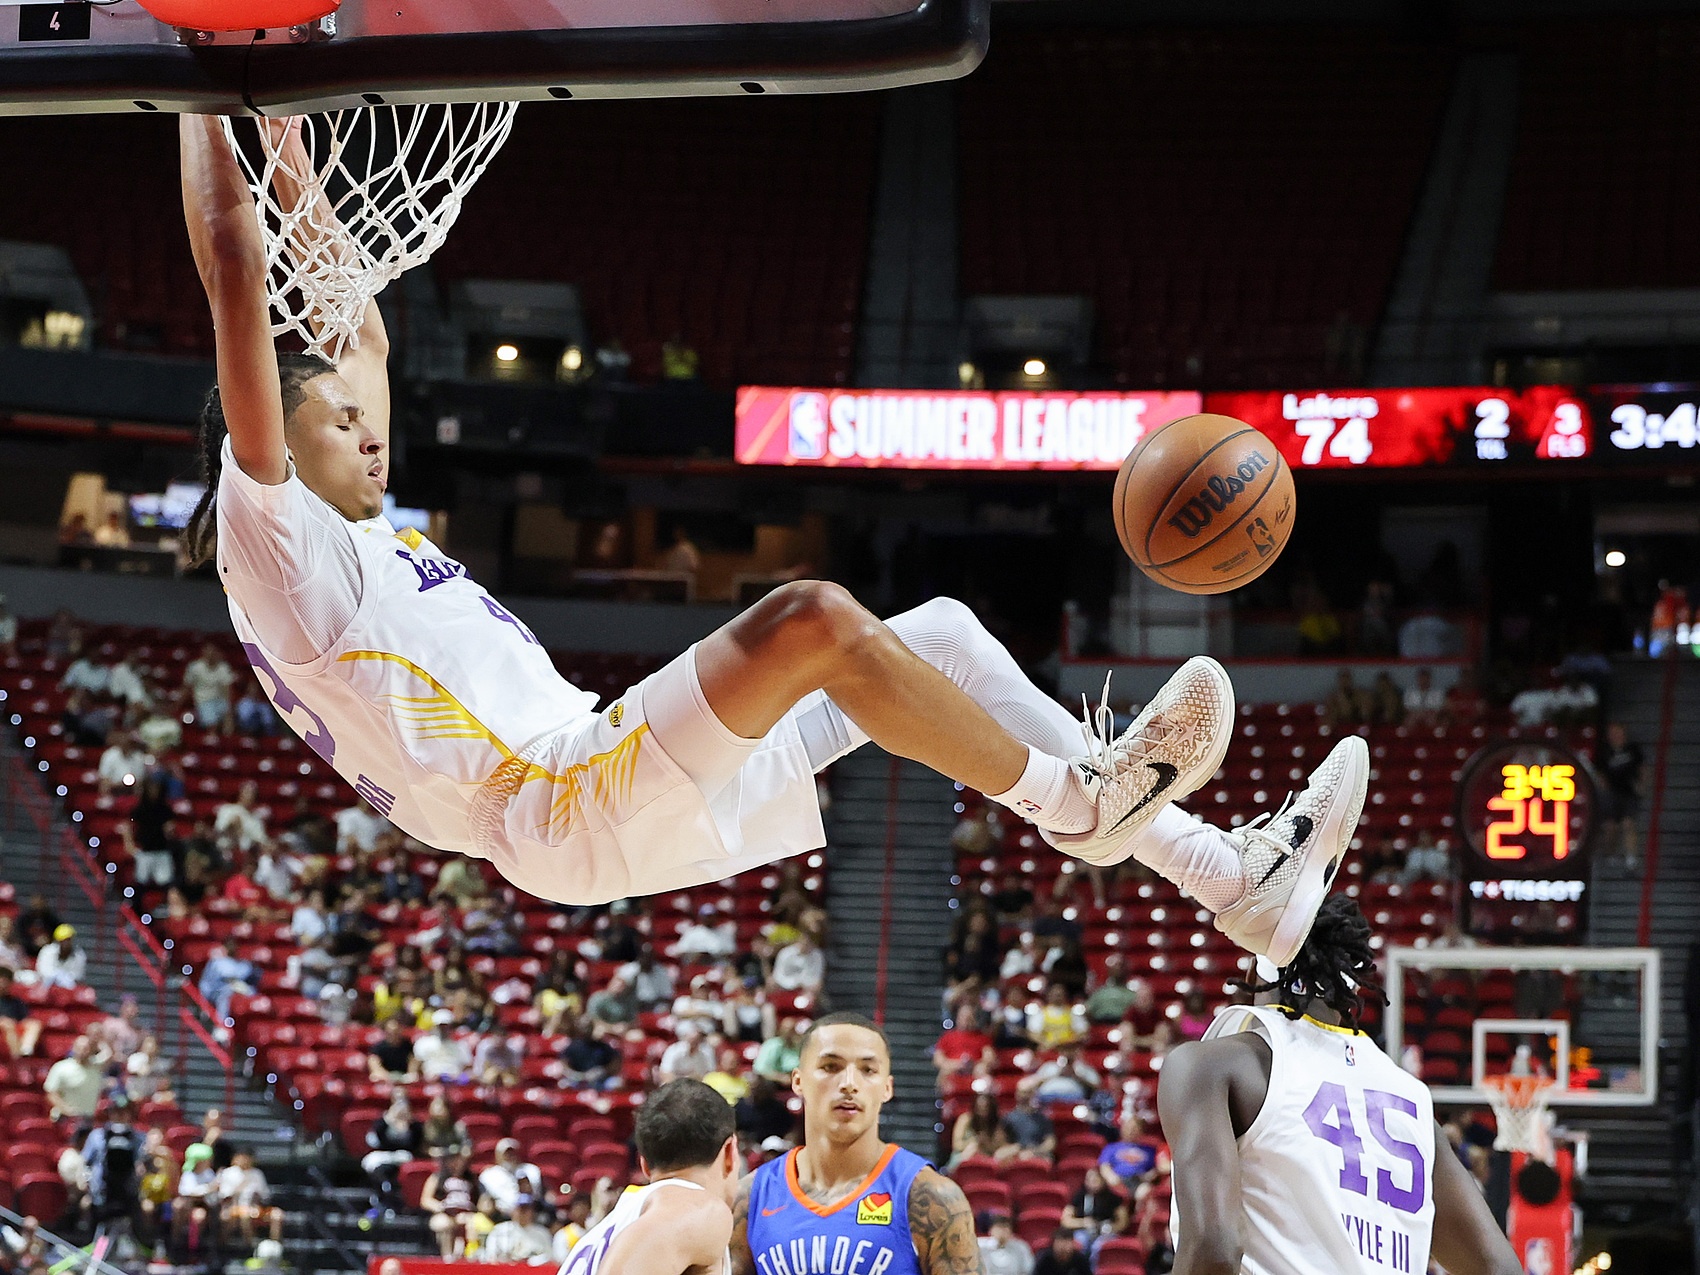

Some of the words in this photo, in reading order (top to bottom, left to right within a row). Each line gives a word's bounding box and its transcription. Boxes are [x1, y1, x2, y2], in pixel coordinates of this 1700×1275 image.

[828, 395, 997, 461] SUMMER
[1002, 398, 1147, 463] LEAGUE
[1295, 418, 1373, 465] 74
[1474, 398, 1510, 439] 2
[1554, 403, 1582, 435] 3
[1610, 402, 1700, 450] 3:4
[1166, 450, 1270, 539] Wilson
[1486, 797, 1569, 860] 24
[1499, 879, 1586, 902] TISSOT
[1302, 1081, 1425, 1214] 45
[757, 1235, 894, 1275] THUNDER
[1391, 1230, 1410, 1274] III
